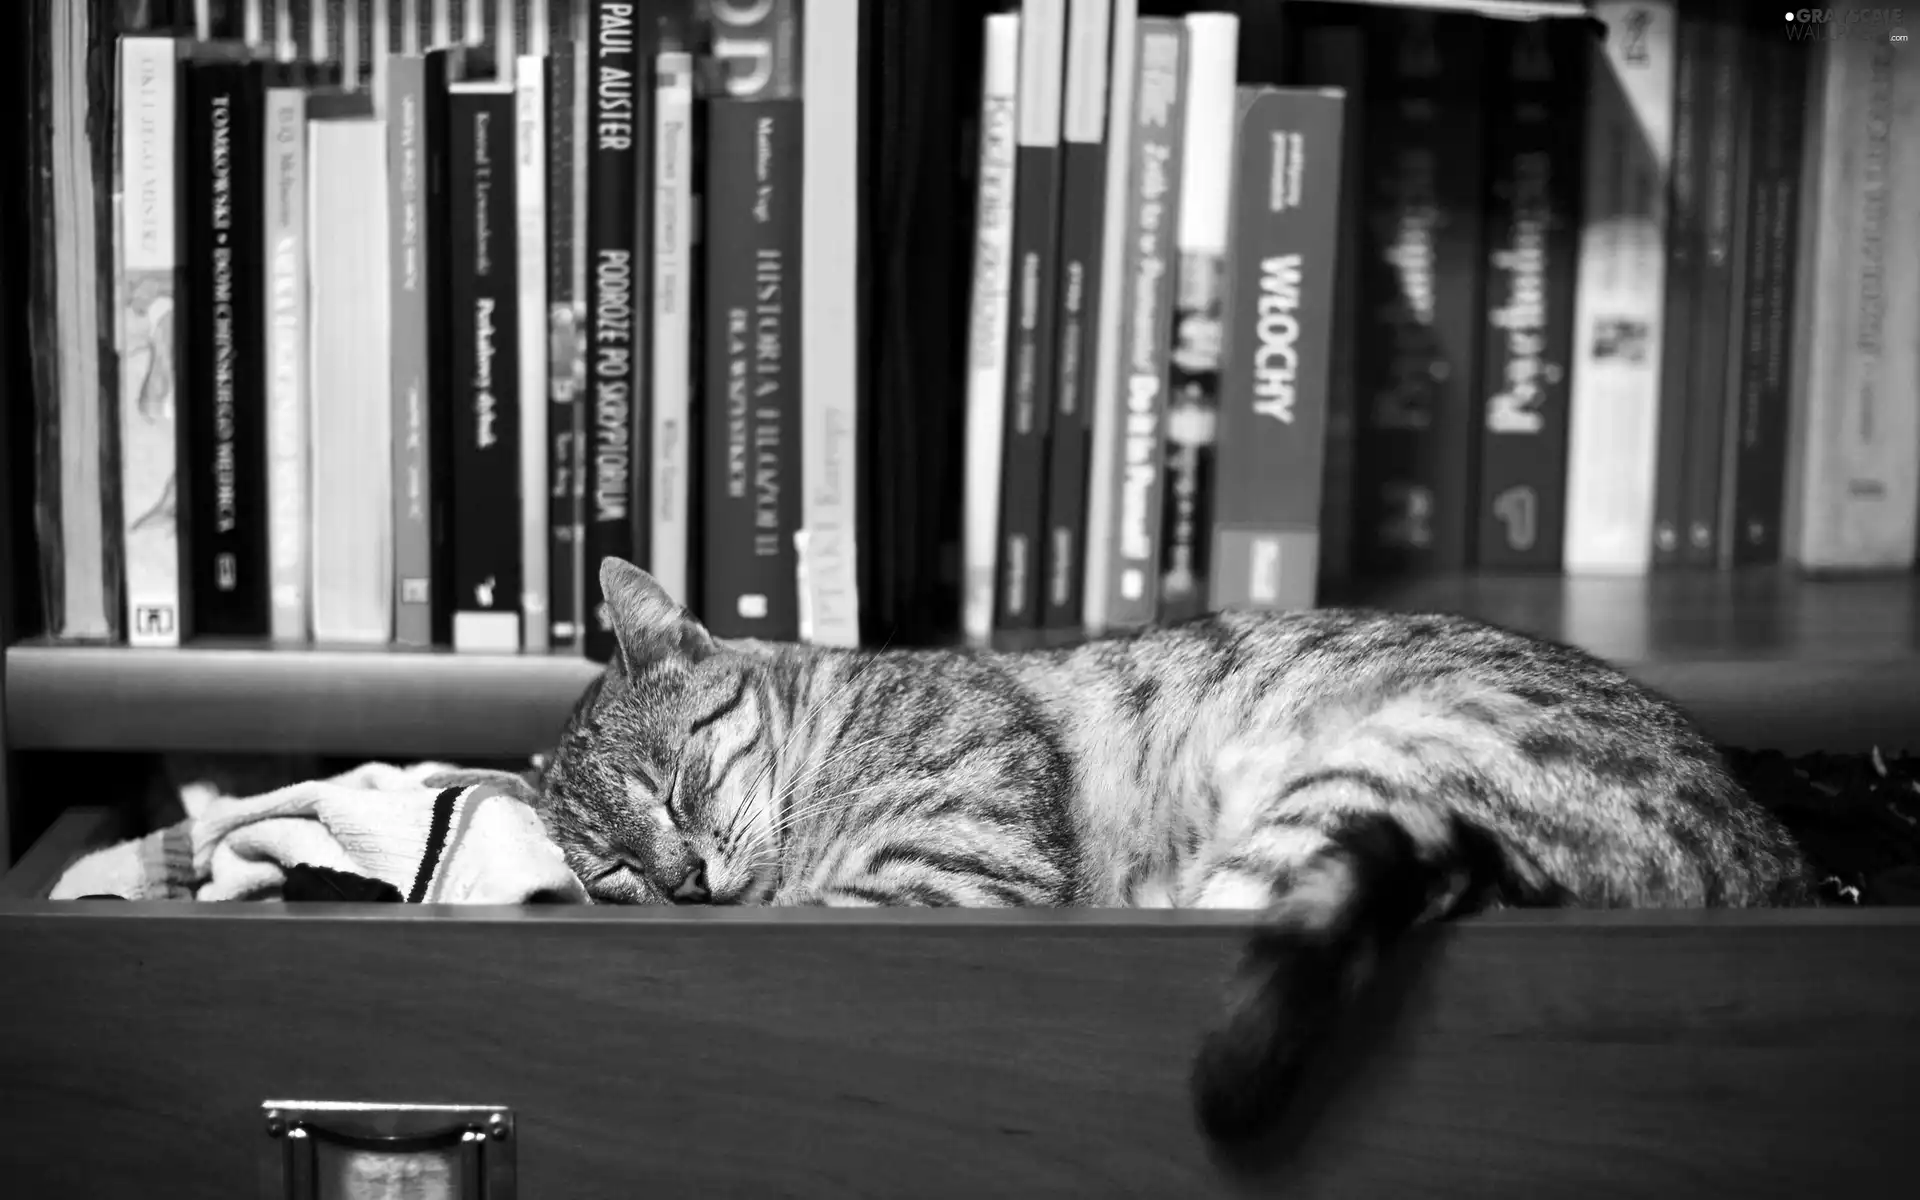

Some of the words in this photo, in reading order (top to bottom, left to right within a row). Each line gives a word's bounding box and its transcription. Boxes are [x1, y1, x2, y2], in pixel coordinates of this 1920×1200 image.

[599, 4, 633, 59] PAUL
[212, 93, 231, 229] TOMKOWSKI
[599, 66, 633, 150] AUSTER
[212, 247, 232, 302] DOM
[755, 247, 783, 398] HISTORIA
[1252, 252, 1304, 425] WŁOCHY
[597, 347, 630, 377] PO
[597, 380, 630, 522] SKRYPTORIUM
[754, 407, 781, 557] FILOZOFII
